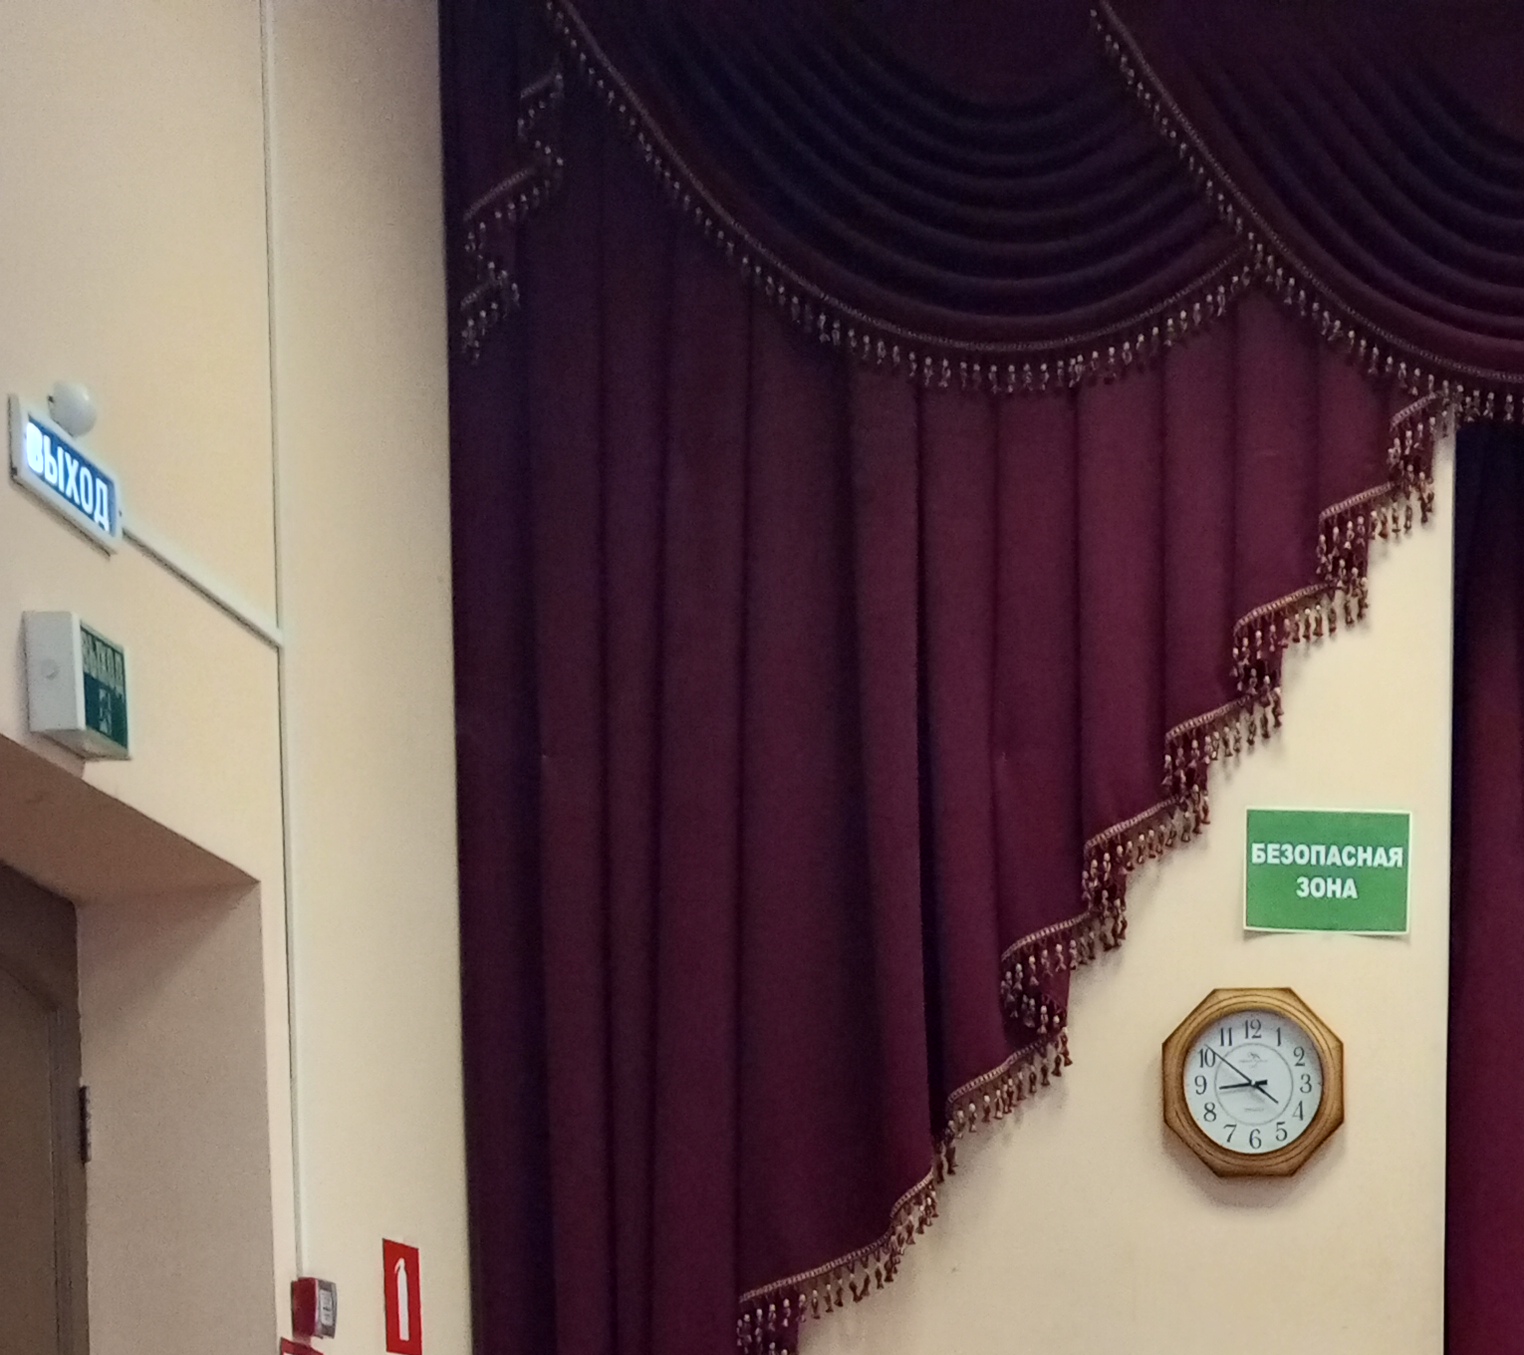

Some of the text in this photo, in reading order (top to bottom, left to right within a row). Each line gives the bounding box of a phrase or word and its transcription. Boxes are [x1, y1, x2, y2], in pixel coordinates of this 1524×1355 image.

[26, 422, 110, 532] ВЫХОД
[1251, 842, 1404, 868] БЕЗОПАСНАЯ
[1296, 876, 1358, 899] ЗОНА
[1220, 1027, 1232, 1046] 11
[1245, 1019, 1262, 1039] 12
[1276, 1027, 1281, 1046] 1
[1199, 1048, 1216, 1068] 10
[1293, 1047, 1305, 1066] 2
[1194, 1075, 1207, 1095] 9
[1300, 1074, 1312, 1093] 3
[1203, 1102, 1216, 1122] 8
[1292, 1100, 1304, 1121] 4
[1223, 1124, 1237, 1143] 7
[1249, 1129, 1262, 1149] 6
[1275, 1121, 1287, 1141] 5
